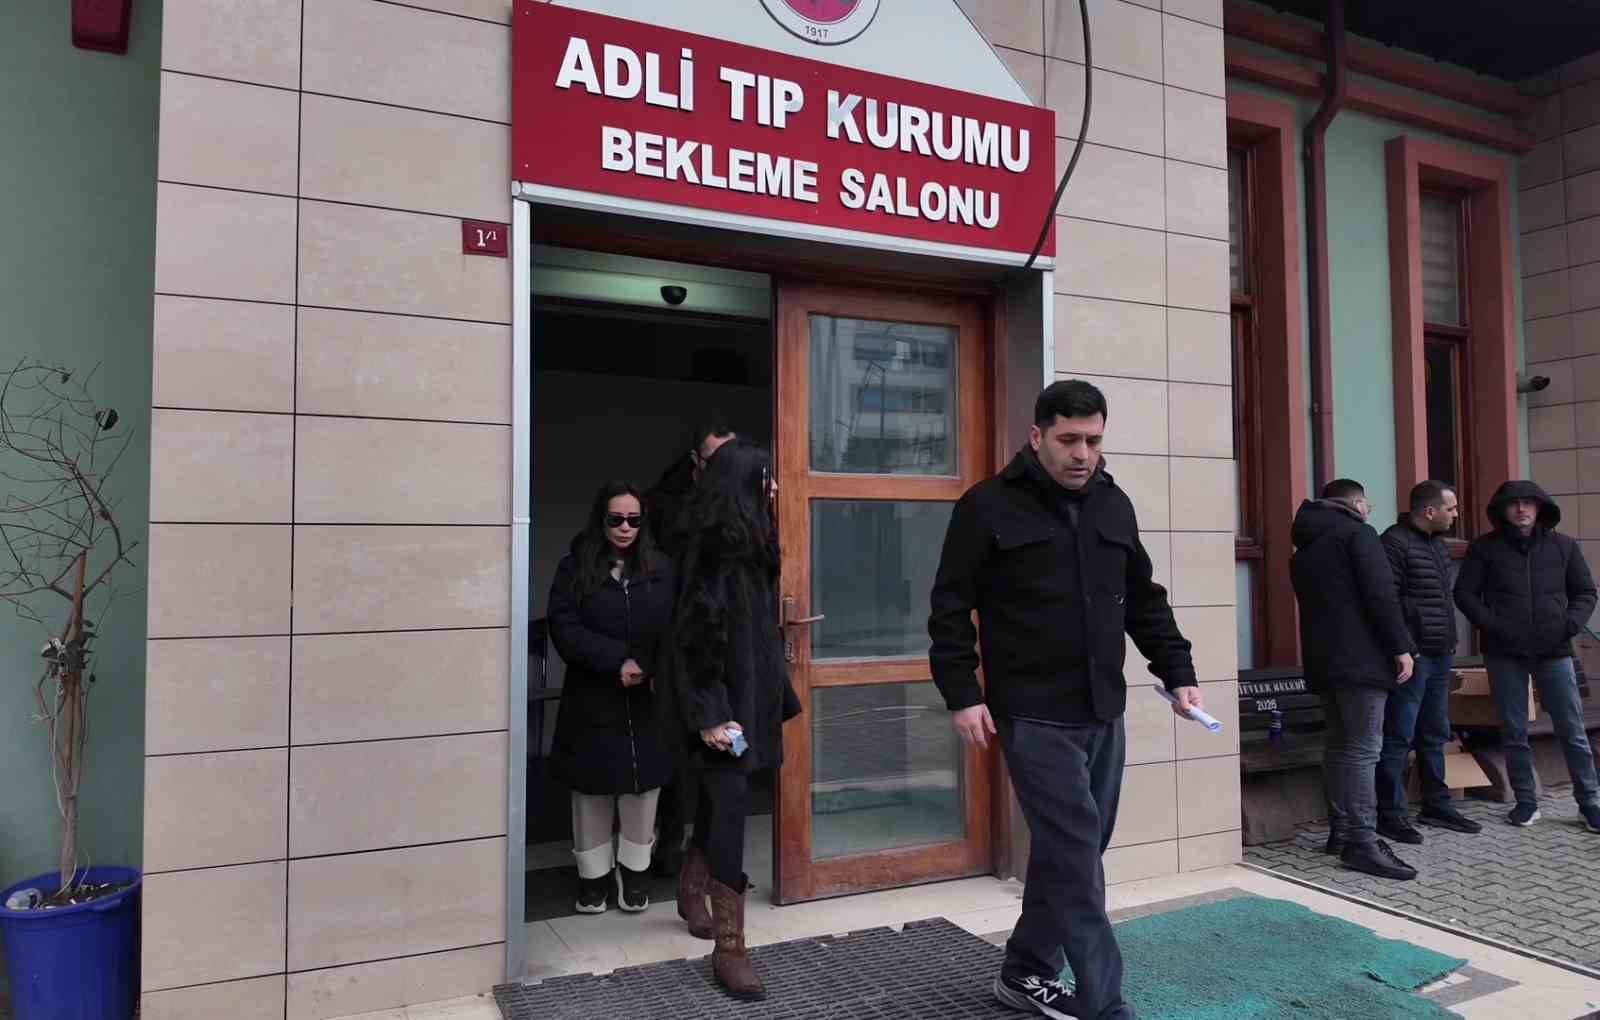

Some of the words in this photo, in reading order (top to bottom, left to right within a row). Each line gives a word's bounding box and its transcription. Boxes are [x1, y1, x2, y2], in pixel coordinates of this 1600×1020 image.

[805, 25, 829, 39] 1917
[555, 36, 695, 111] ADLİ
[720, 66, 804, 129] TIP
[826, 89, 1030, 173] KURUMU
[601, 126, 819, 202] BEKLEME
[840, 168, 1000, 228] SALONU
